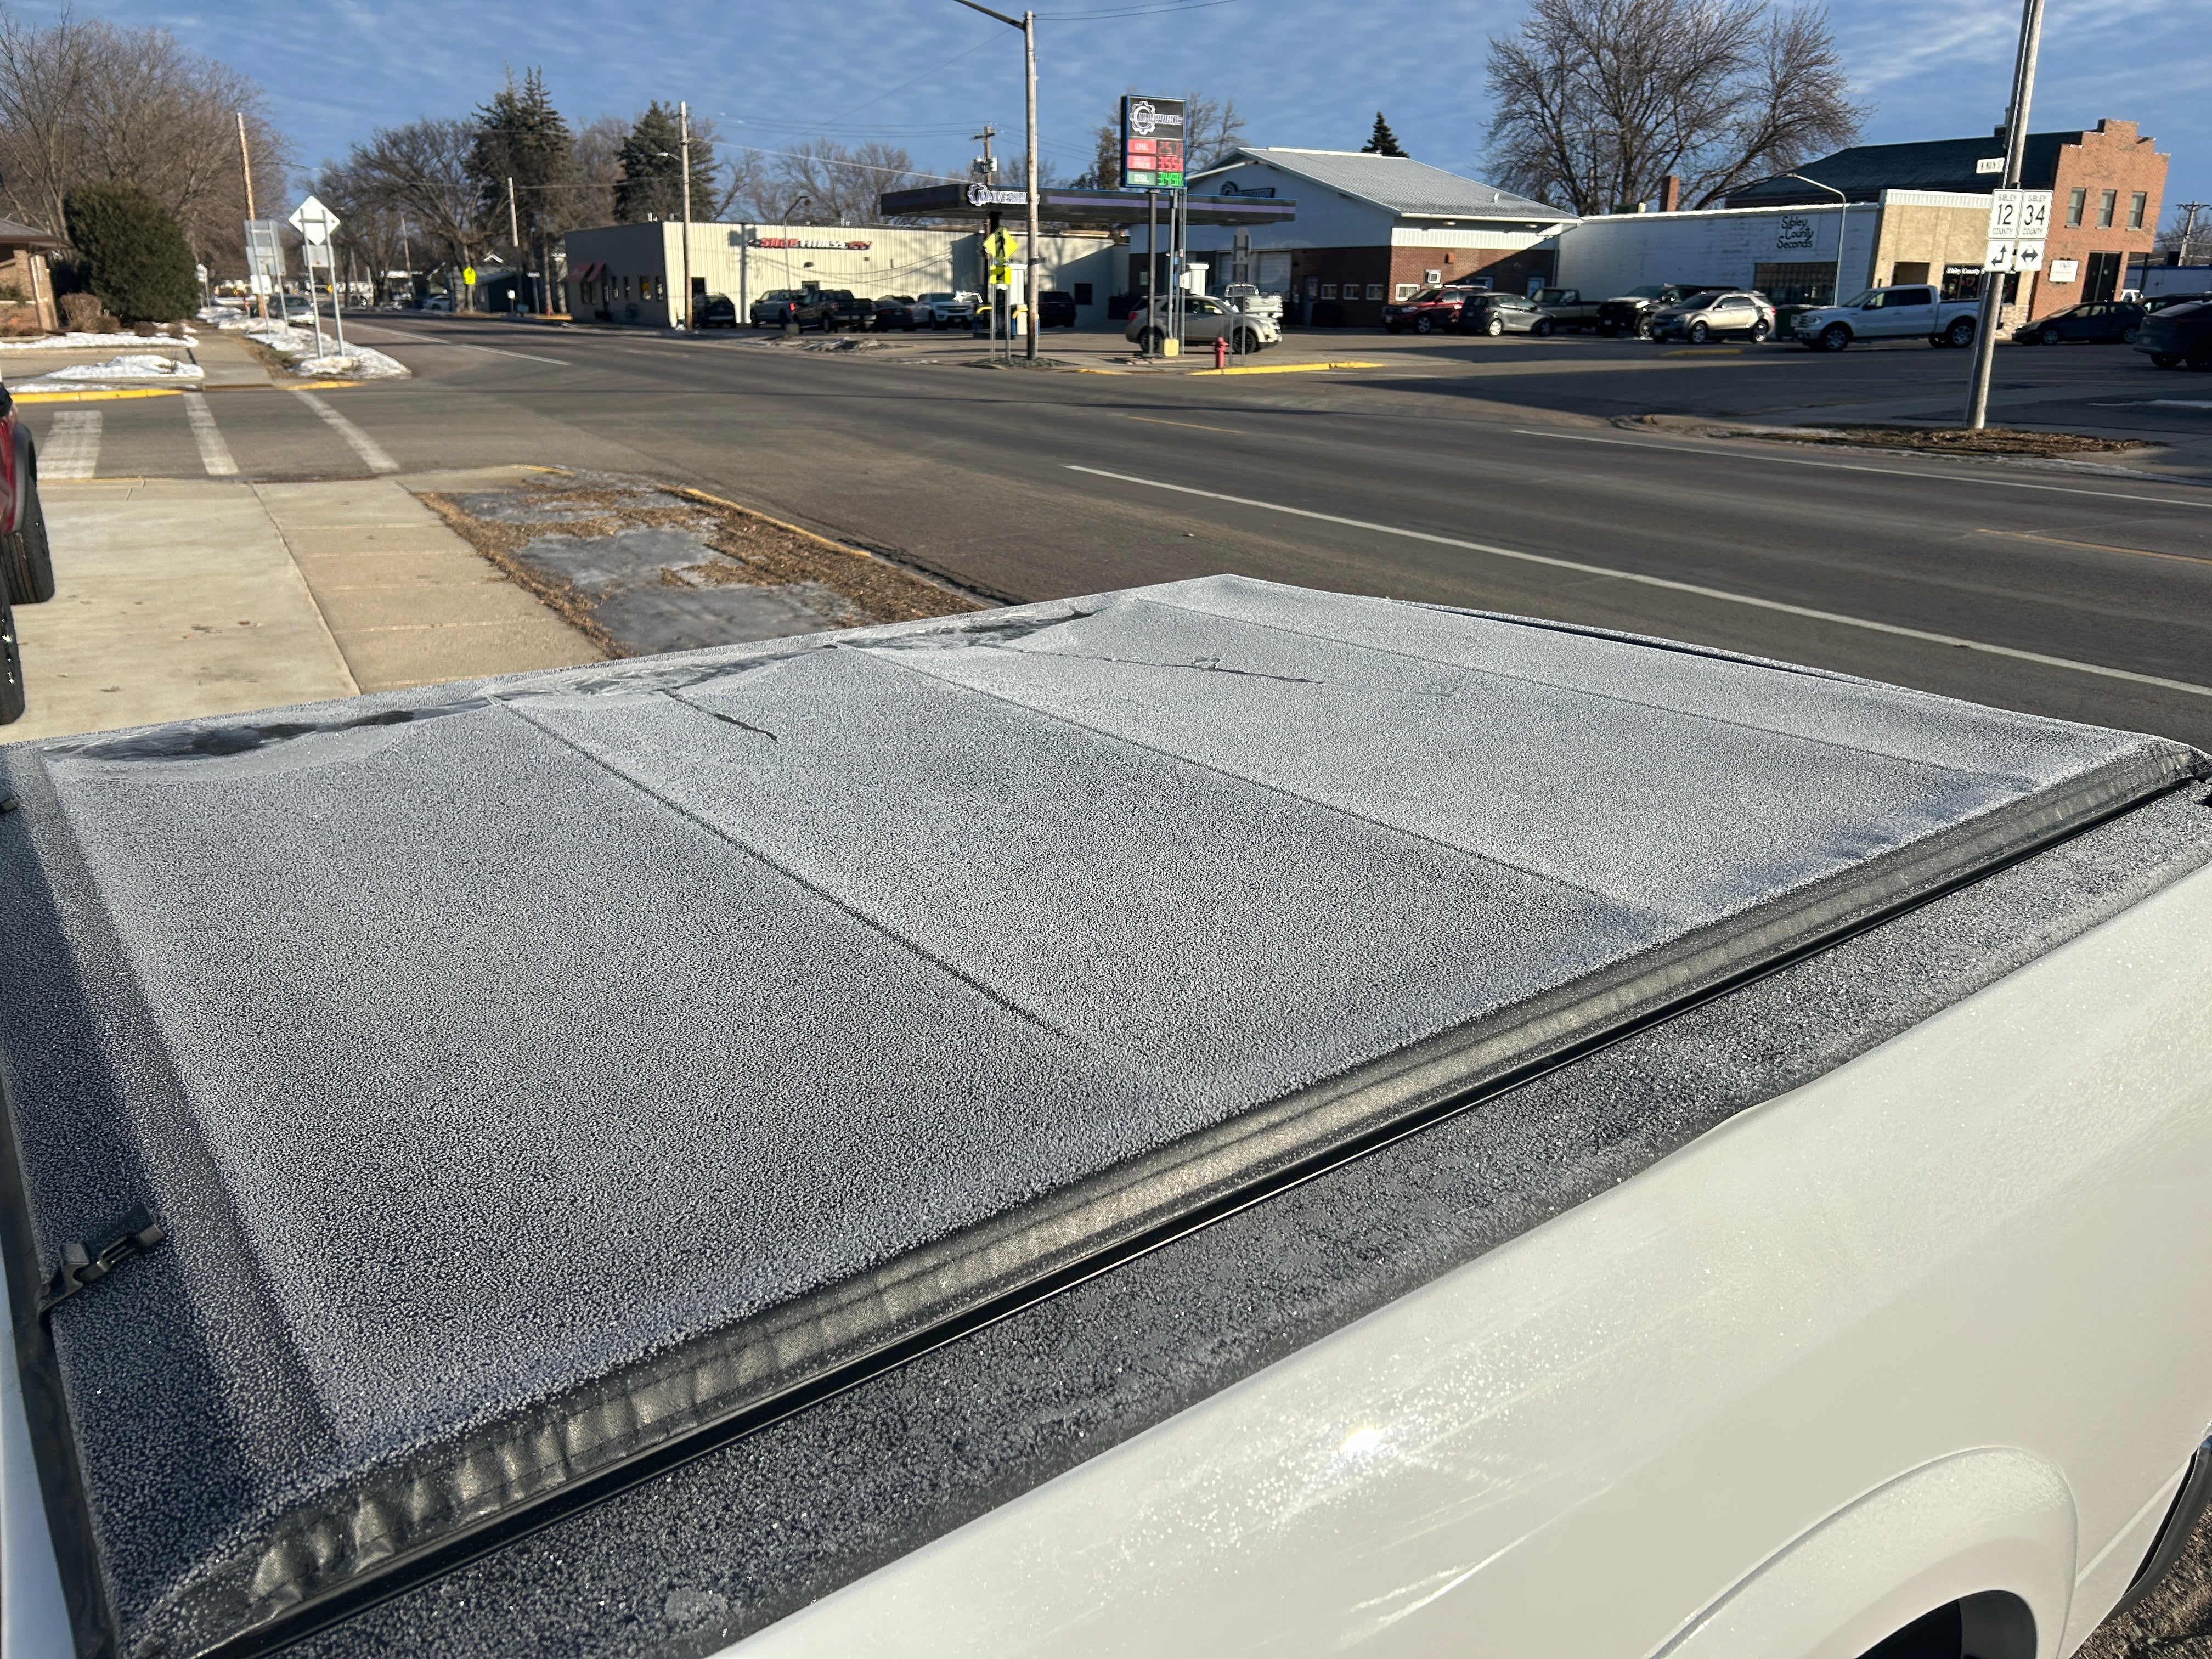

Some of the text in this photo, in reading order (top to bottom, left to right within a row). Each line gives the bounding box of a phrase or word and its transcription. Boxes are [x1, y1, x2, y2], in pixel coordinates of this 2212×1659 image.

[1997, 204, 2013, 225] 12
[2024, 204, 2046, 226] 34
[1992, 227, 2013, 235] COUNTY
[1777, 235, 1813, 249] Seconds
